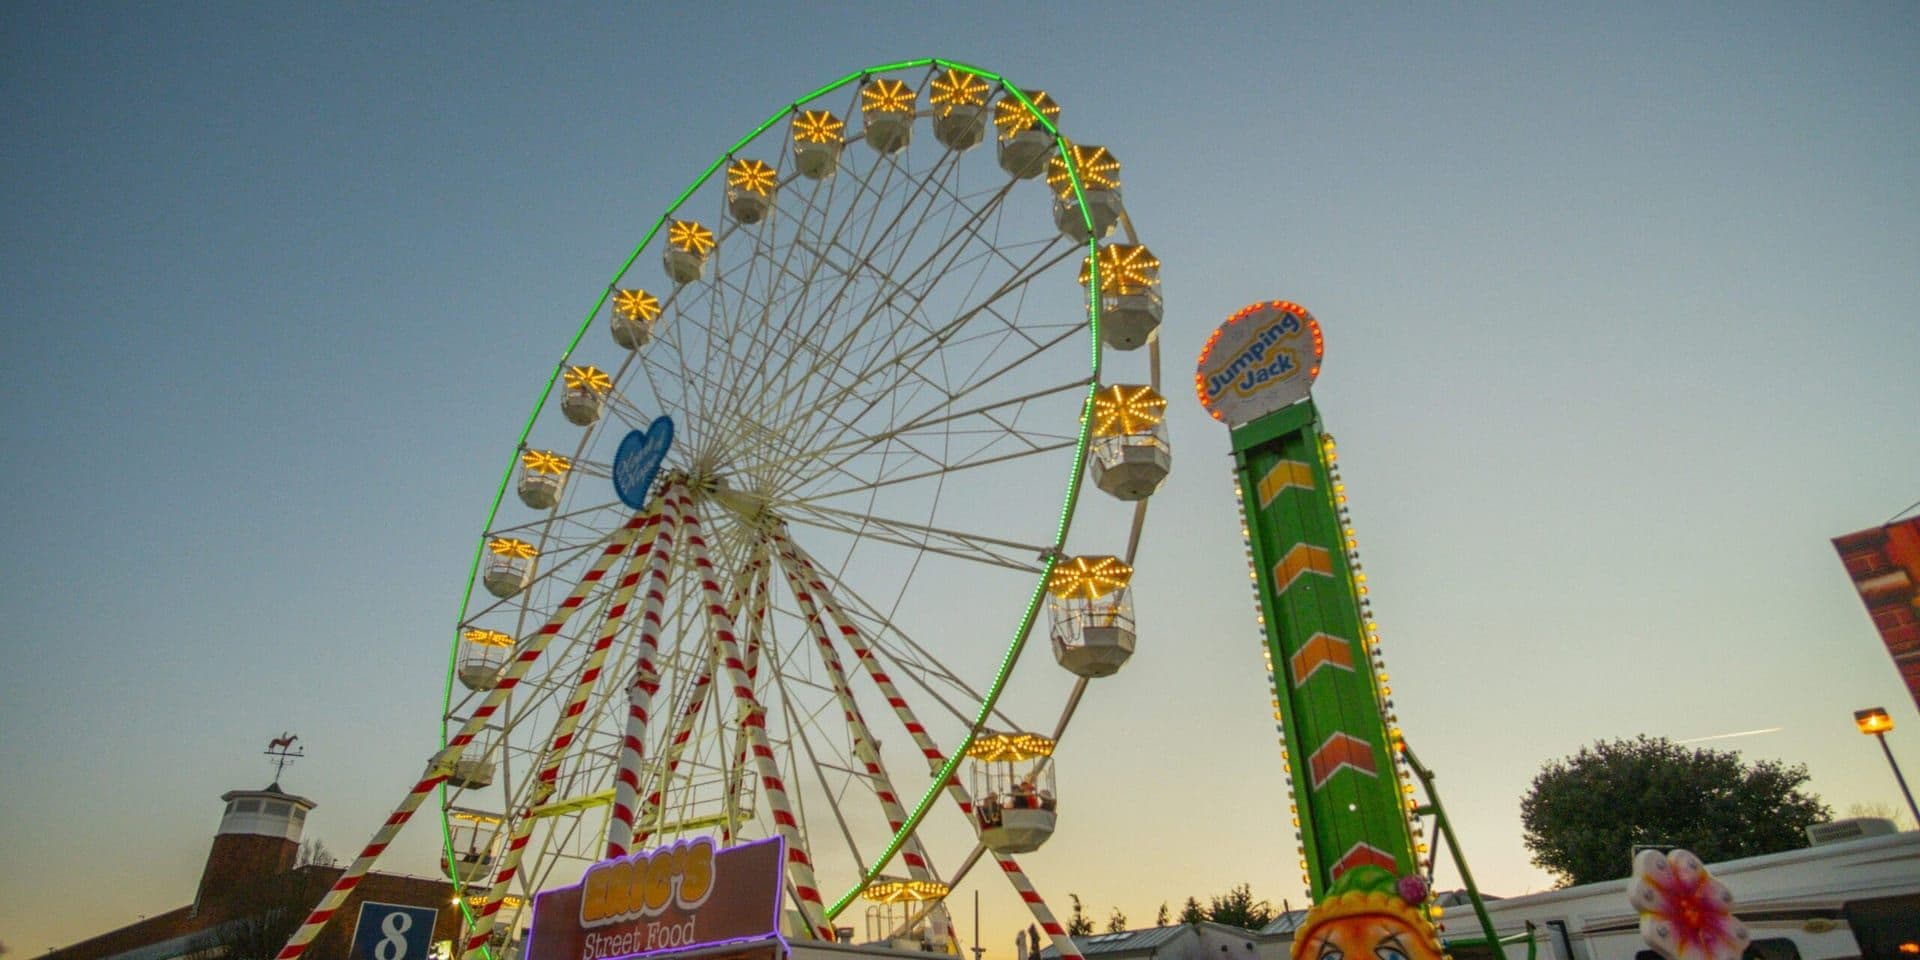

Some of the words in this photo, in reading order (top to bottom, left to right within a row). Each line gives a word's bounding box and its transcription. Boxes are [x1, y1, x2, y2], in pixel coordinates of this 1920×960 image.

[1207, 312, 1299, 396] Jumping
[1240, 354, 1293, 390] Jack
[374, 911, 413, 960] 8
[583, 926, 640, 960] Street
[645, 914, 697, 951] Food
